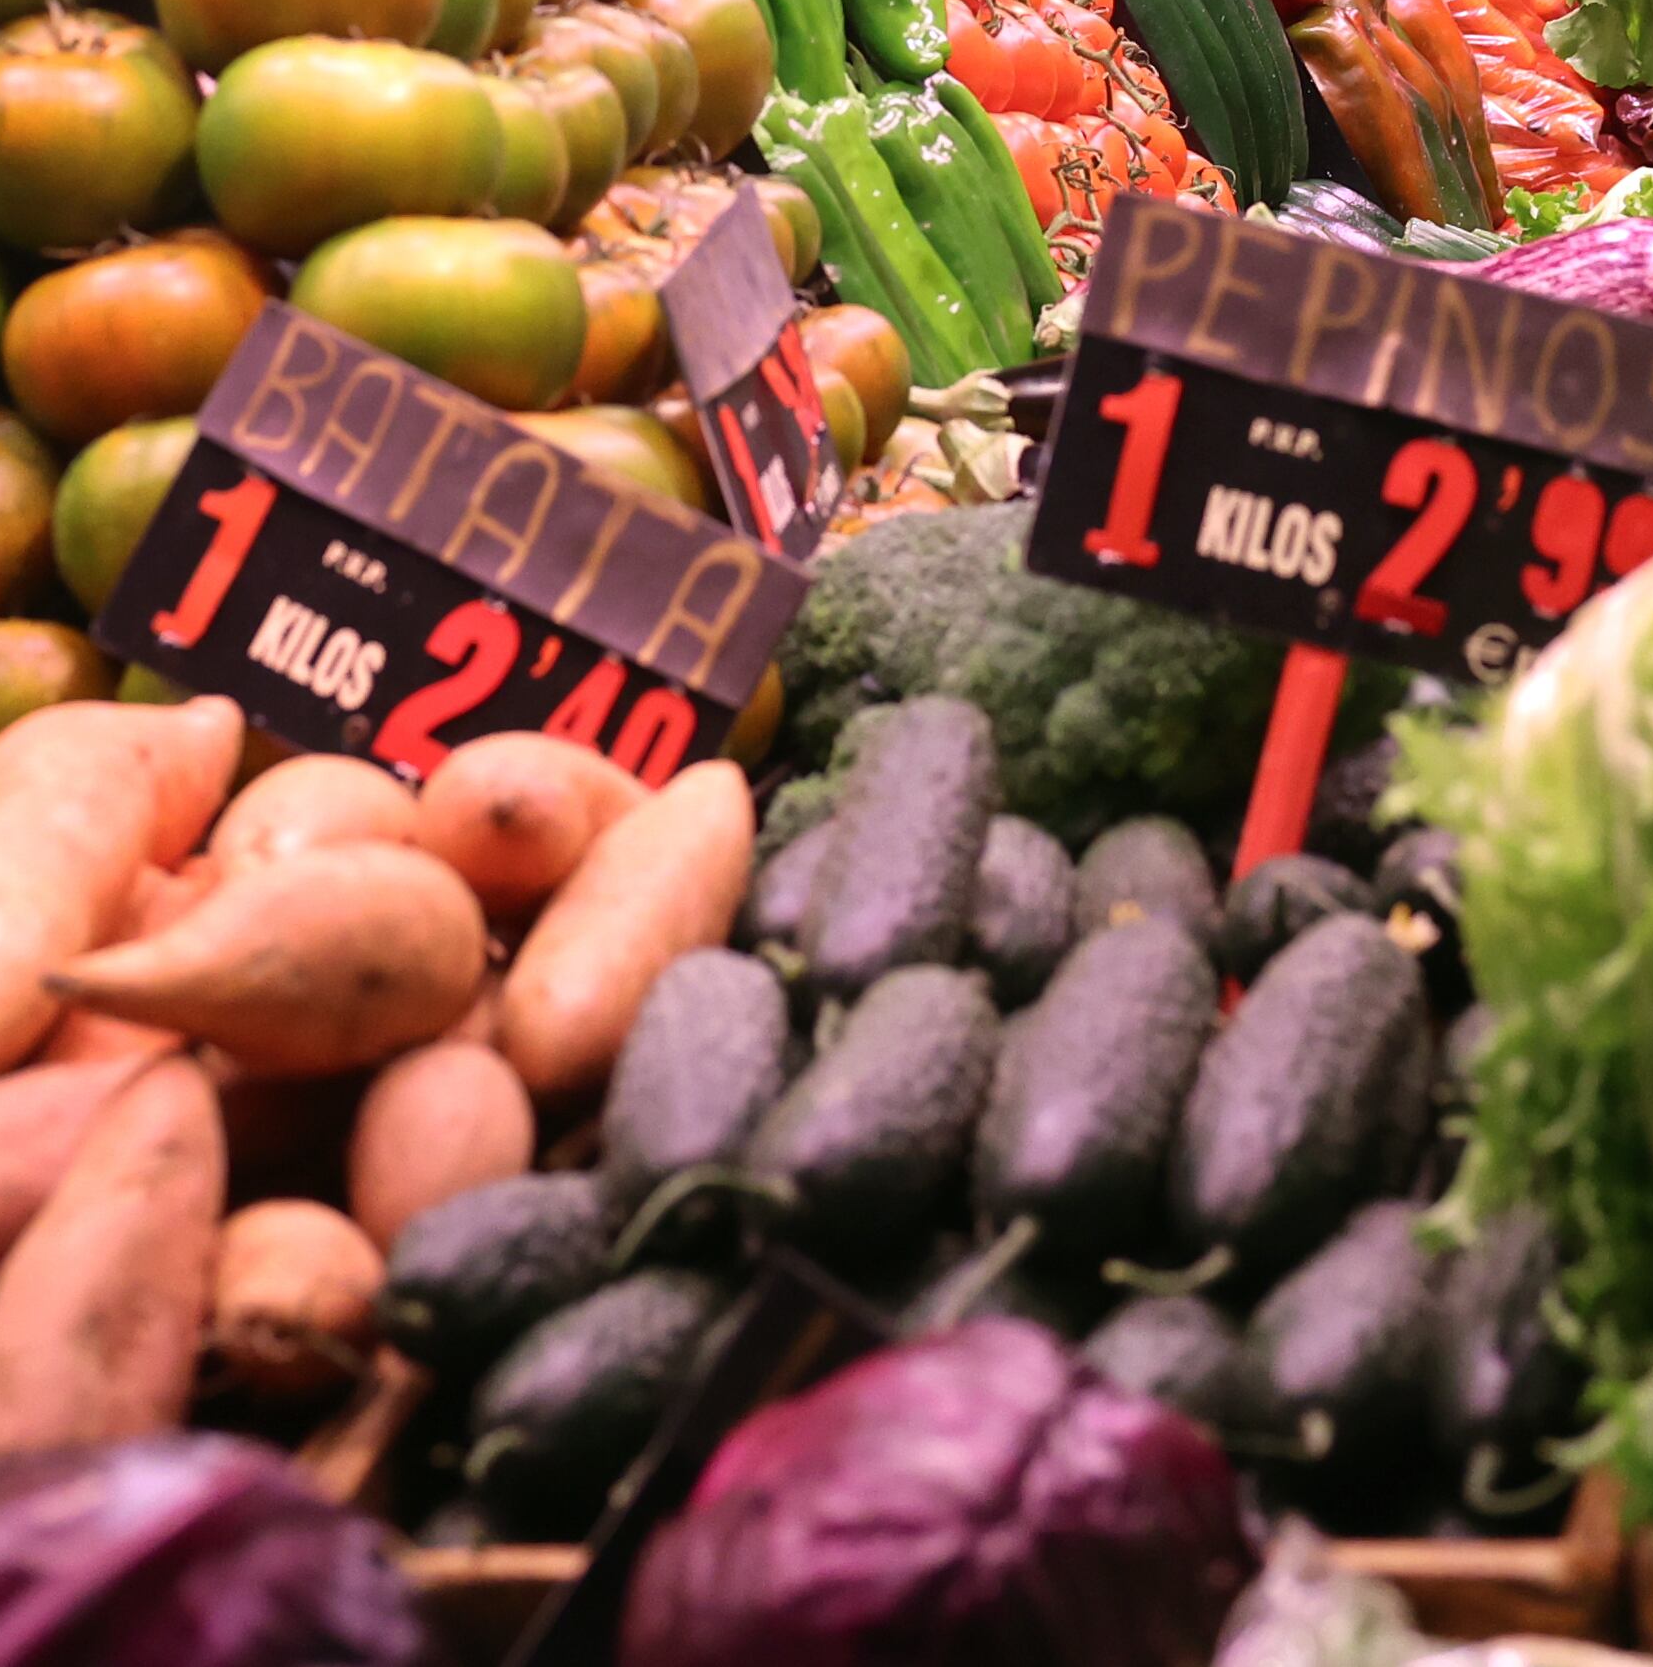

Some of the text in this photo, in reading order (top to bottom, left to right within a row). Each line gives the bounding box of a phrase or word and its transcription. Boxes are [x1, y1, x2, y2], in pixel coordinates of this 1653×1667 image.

[151, 476, 281, 649] 1
[248, 594, 388, 711] KILOS
[231, 317, 762, 692] BATATA
[1084, 371, 1184, 567] 1
[1196, 483, 1344, 587] KILOS
